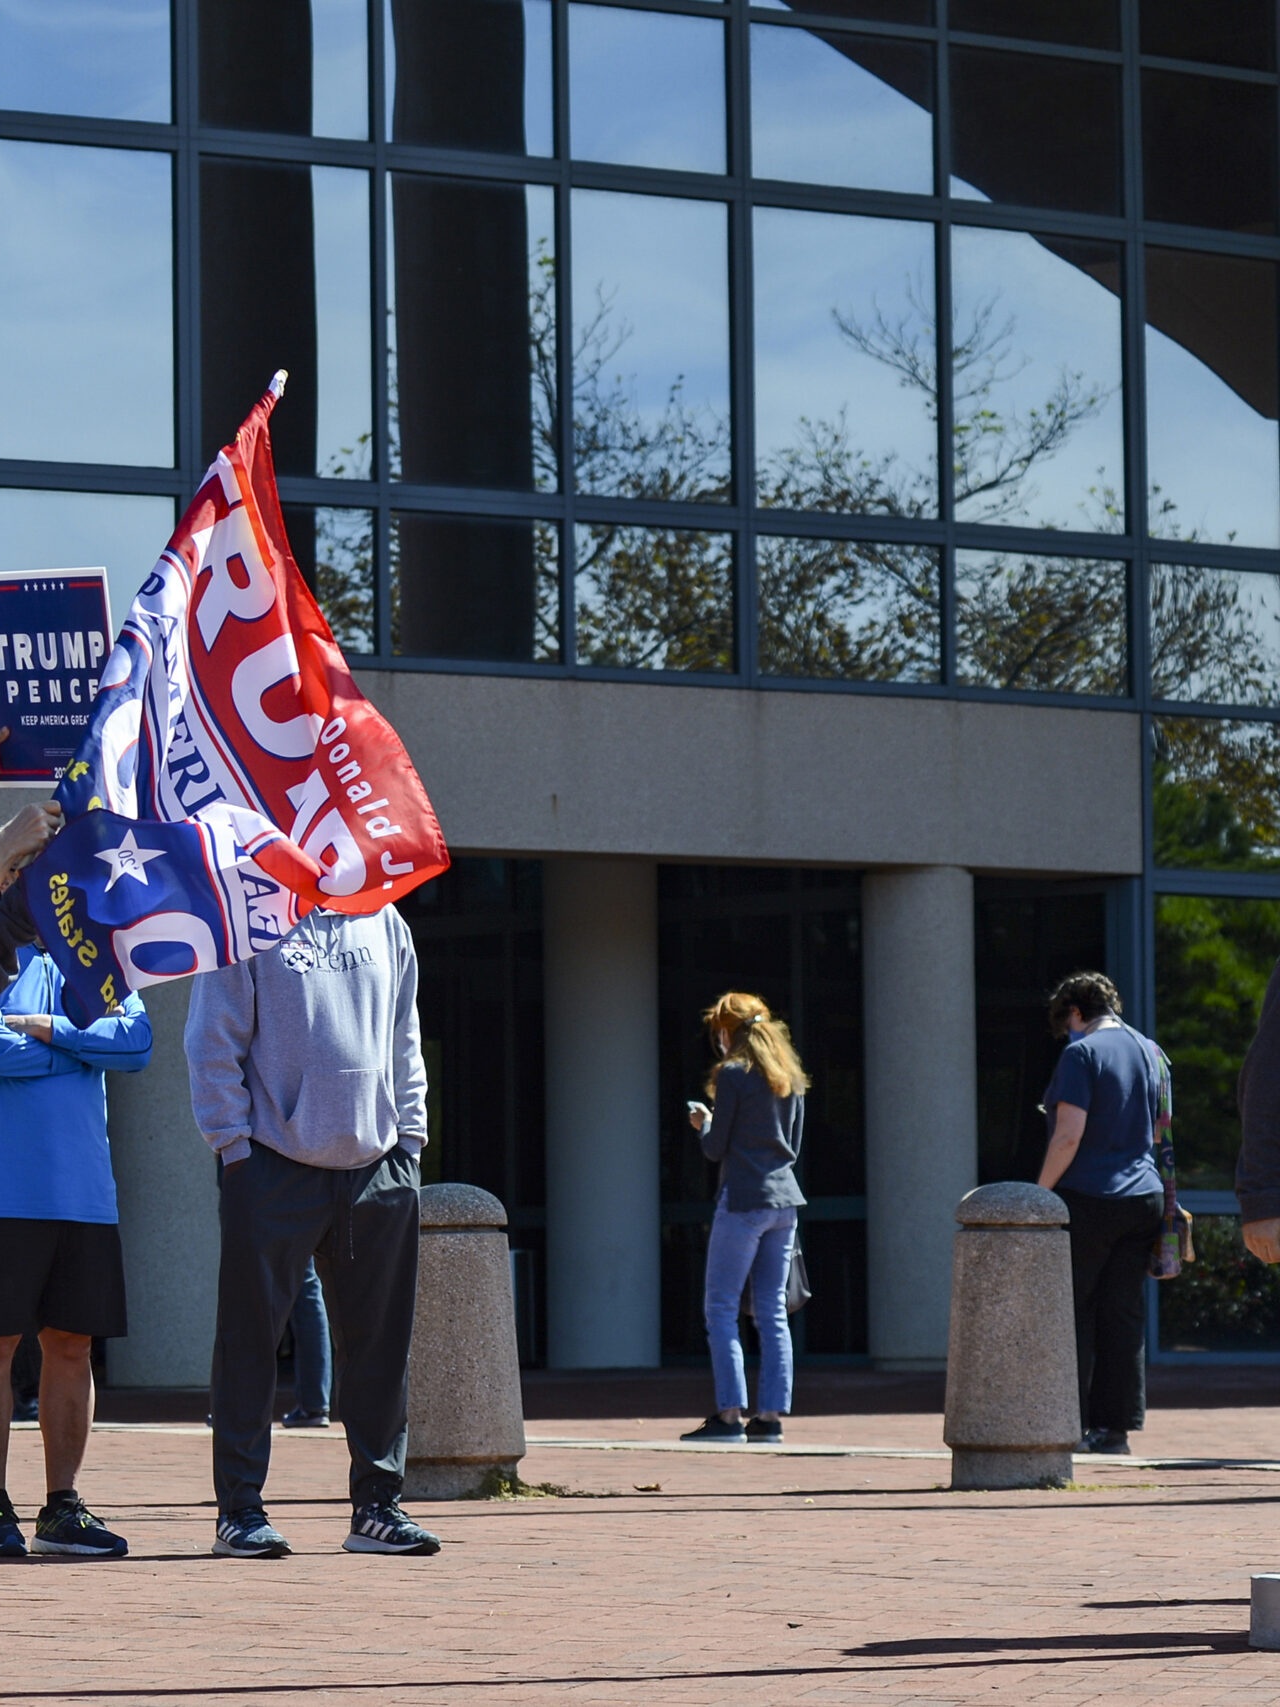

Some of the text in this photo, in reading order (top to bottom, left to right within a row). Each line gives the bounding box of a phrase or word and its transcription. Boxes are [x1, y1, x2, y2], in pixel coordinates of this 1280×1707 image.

[21, 714, 90, 726] KEEP AMERICA GREA
[321, 716, 414, 889] Donald J.
[314, 946, 373, 970] Penn
